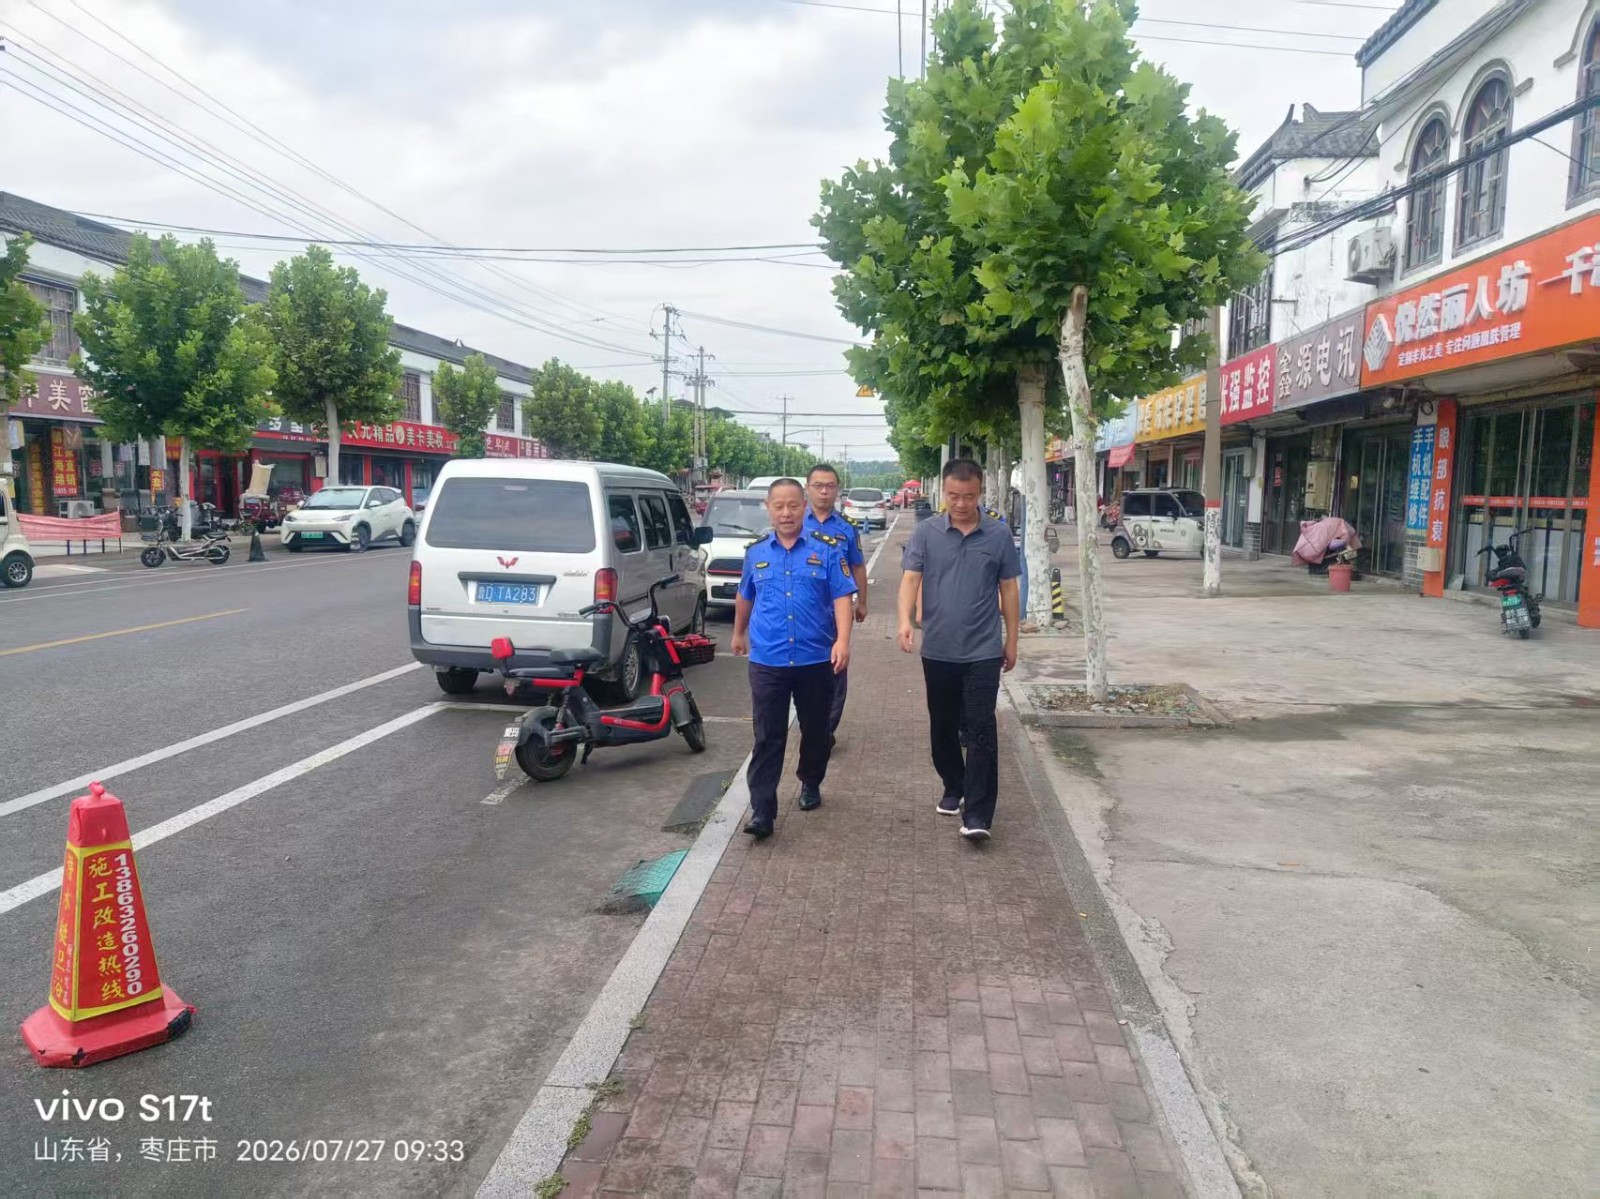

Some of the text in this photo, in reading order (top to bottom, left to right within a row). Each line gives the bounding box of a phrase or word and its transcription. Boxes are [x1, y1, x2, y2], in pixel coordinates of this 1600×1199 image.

[1279, 325, 1356, 399] 鑫源电讯
[1408, 428, 1423, 526] 手机维修
[1418, 427, 1433, 527] 手机配件
[1432, 427, 1450, 541] 眼部抗衰
[88, 855, 125, 1002] 施工改造热线
[114, 853, 143, 996] 13863260290
